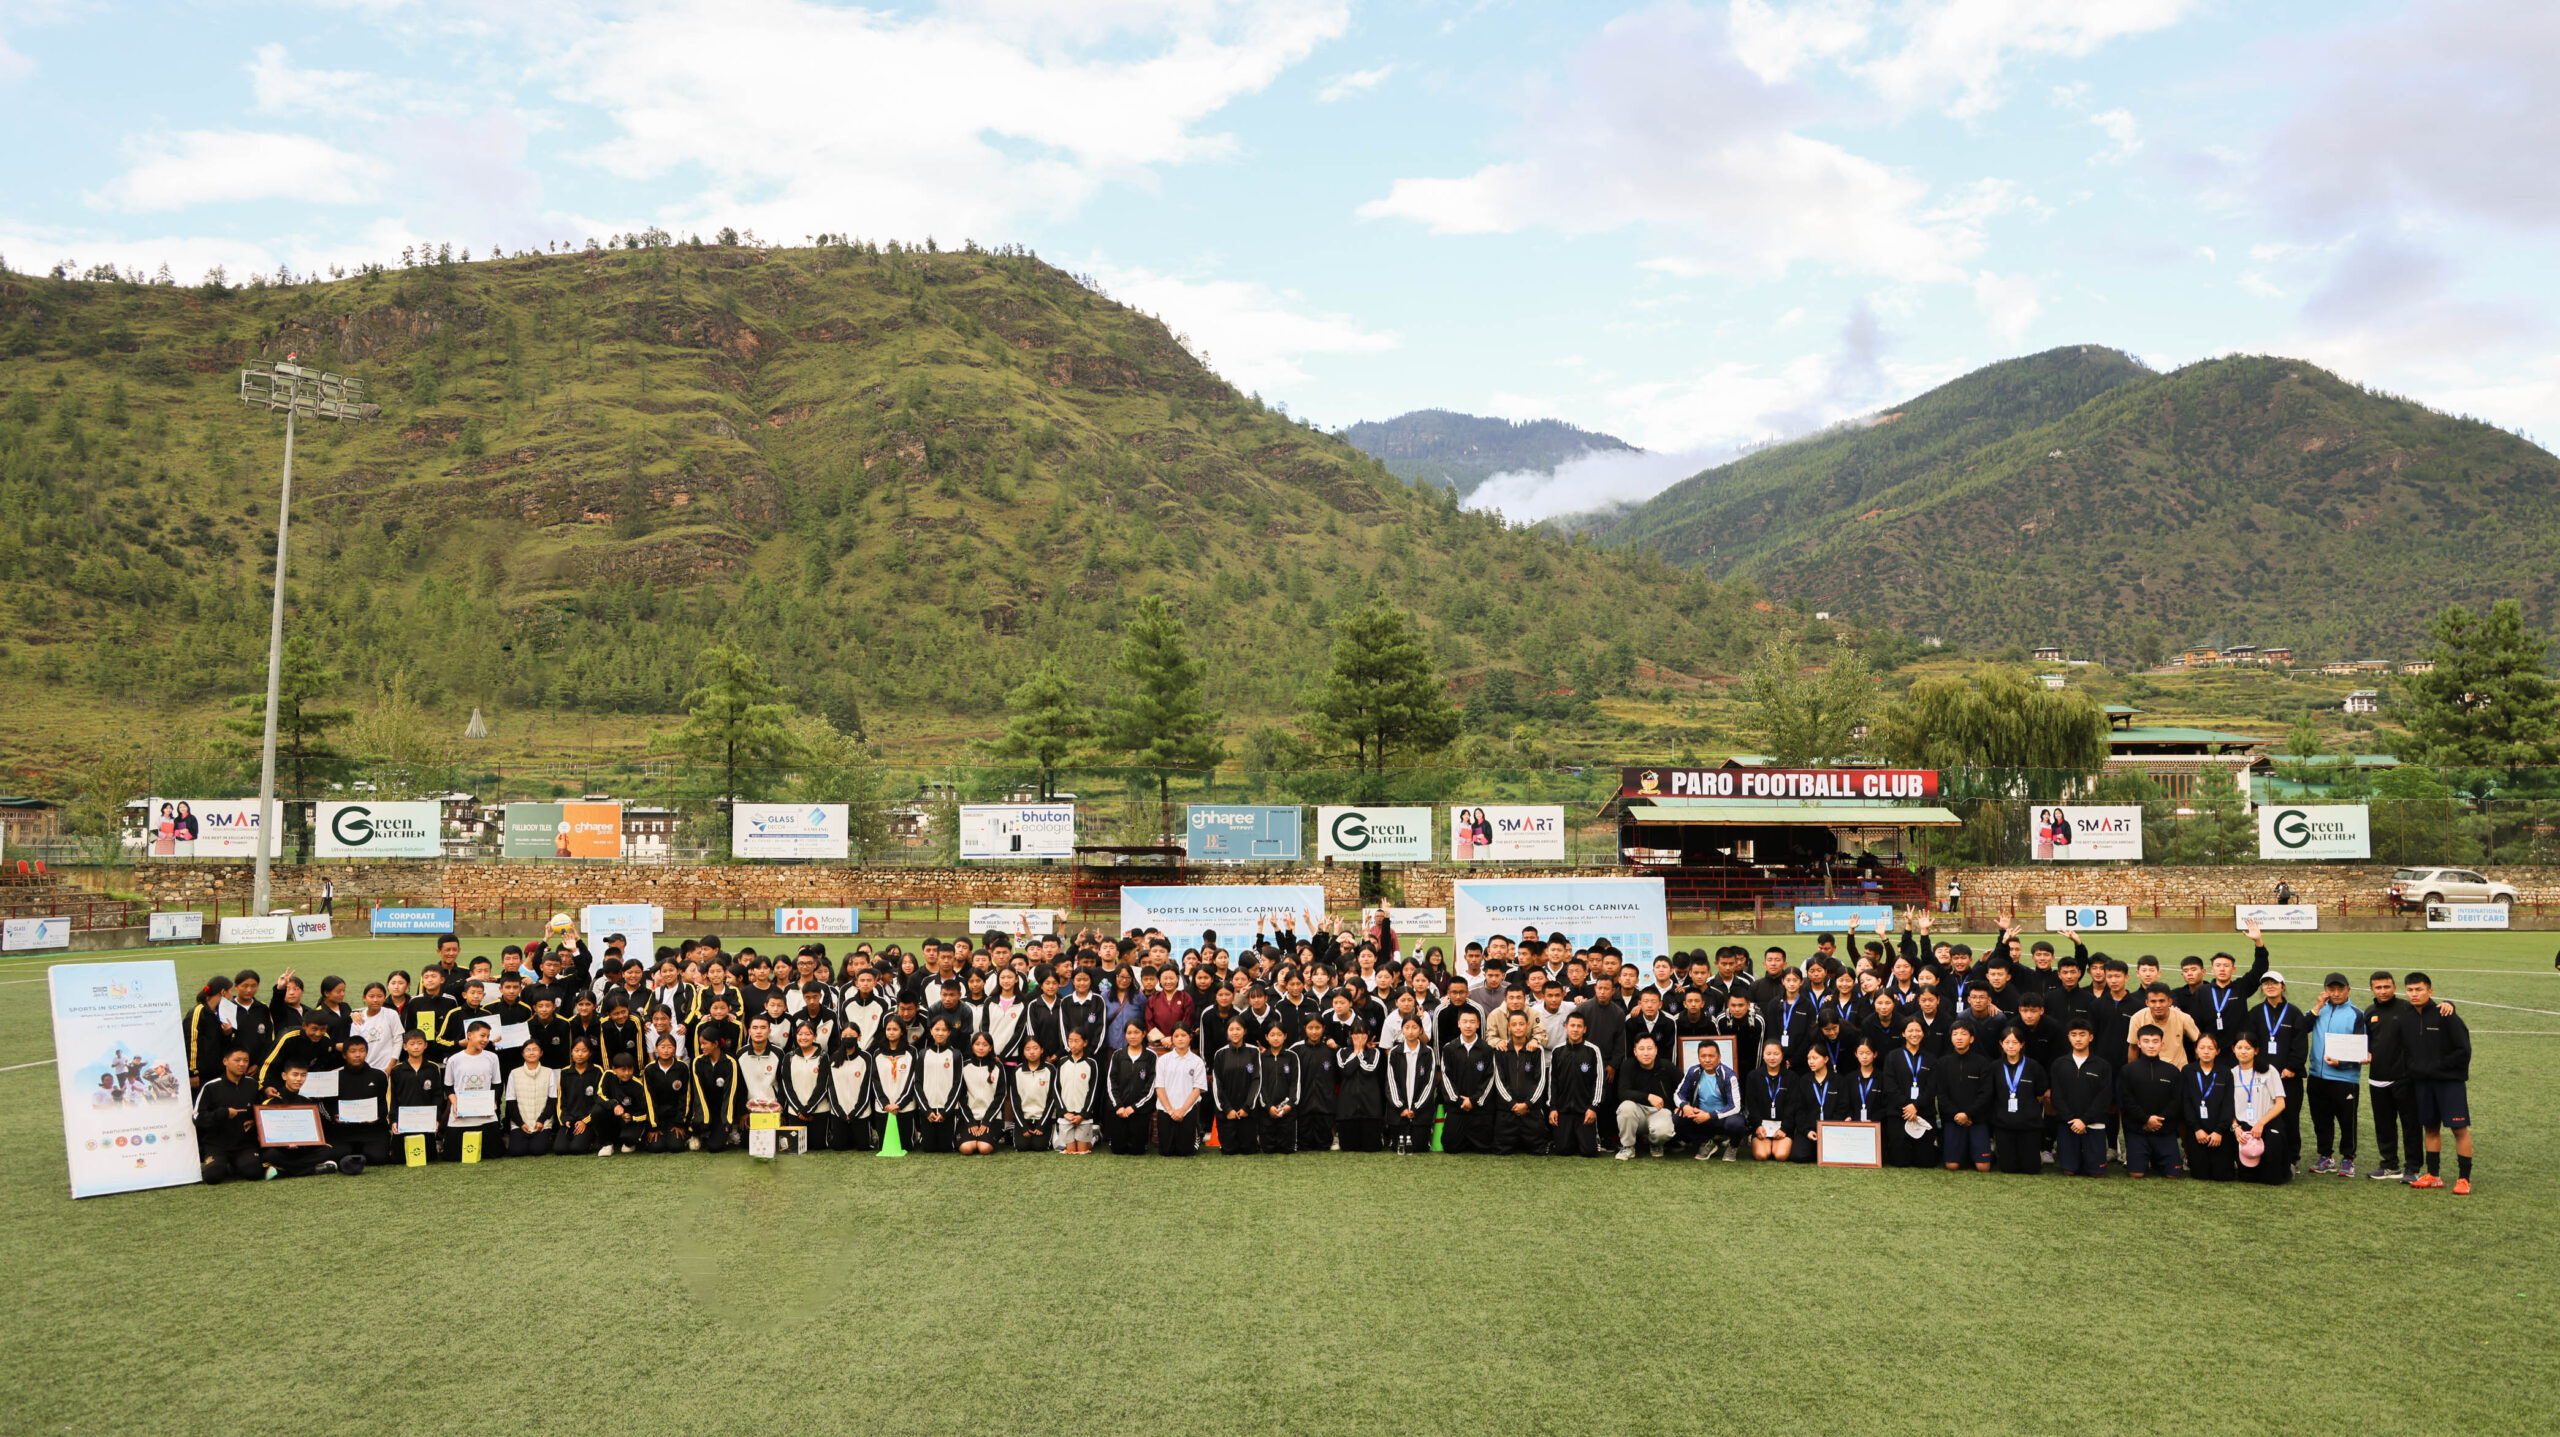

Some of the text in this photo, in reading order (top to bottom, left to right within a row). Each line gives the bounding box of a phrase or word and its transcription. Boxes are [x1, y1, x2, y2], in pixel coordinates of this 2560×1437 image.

[1671, 771, 1923, 798] PARO FOOTBALL CLUB
[206, 811, 260, 827] SMAR
[1022, 811, 1071, 822] bhutan
[1022, 823, 1071, 835] ecologic
[1498, 816, 1554, 831] SMART
[2077, 817, 2131, 832] SMART
[1147, 907, 1185, 915] SPORTS
[1485, 905, 1525, 913] SPORTS
[1544, 904, 1585, 912] SCHOOL
[1589, 903, 1640, 911] CARNIVAL
[389, 912, 436, 920] CORPORATE
[786, 909, 819, 931] ria
[2066, 909, 2107, 927] BOB
[376, 920, 411, 928] NTERNET
[138, 1001, 173, 1009] CARNIVAL
